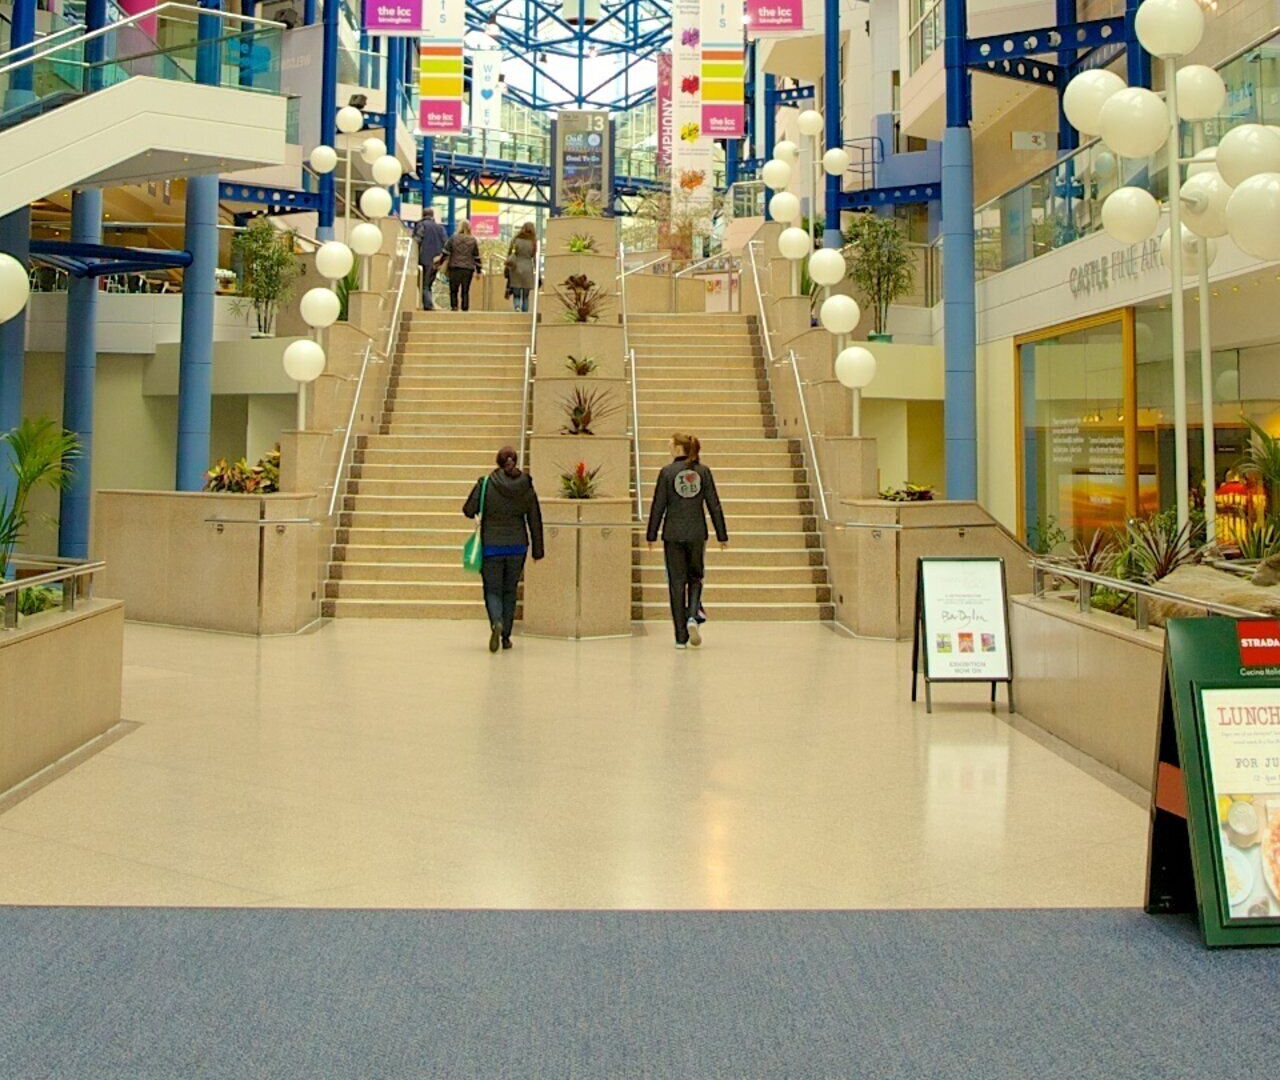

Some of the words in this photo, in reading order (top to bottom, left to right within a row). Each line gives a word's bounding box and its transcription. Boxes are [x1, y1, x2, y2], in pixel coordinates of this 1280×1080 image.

[377, 5, 395, 17] the
[397, 5, 412, 17] icc
[758, 6, 775, 18] the
[778, 6, 792, 18] icc
[1240, 637, 1280, 648] STRADA
[1240, 668, 1265, 676] Cucina
[1235, 757, 1259, 769] FOR
